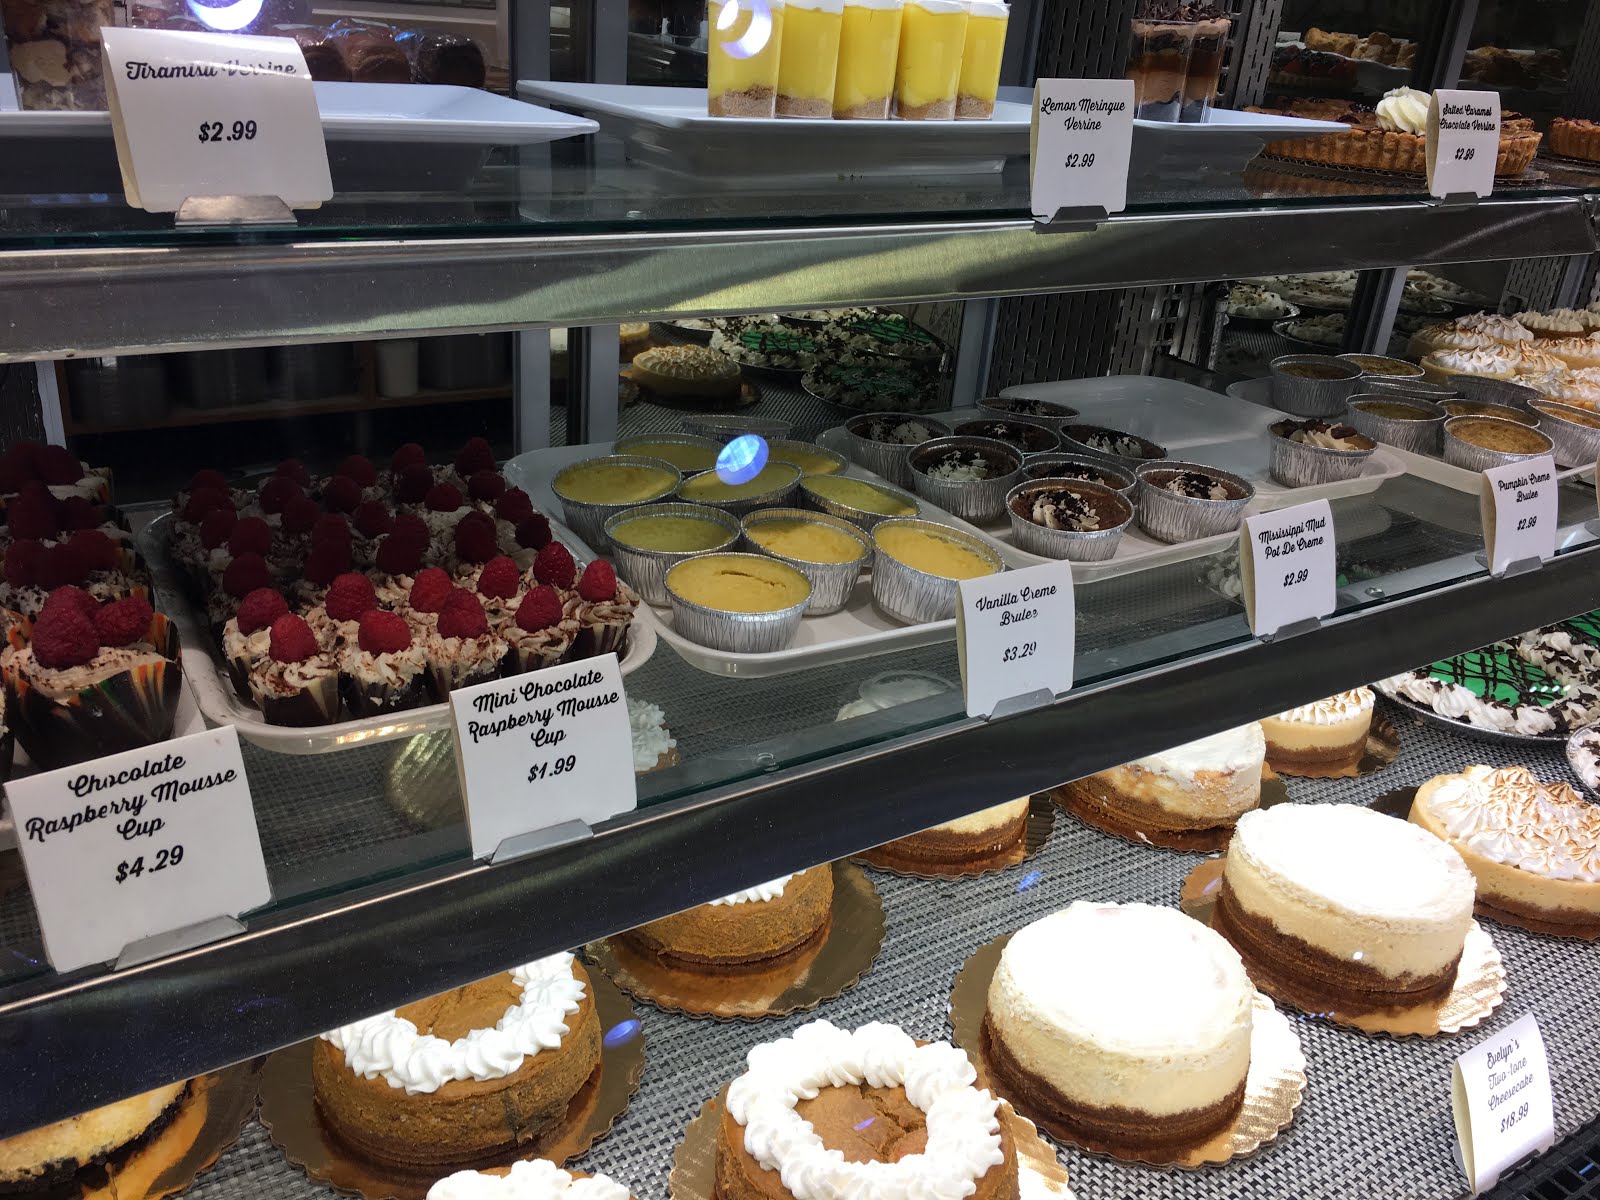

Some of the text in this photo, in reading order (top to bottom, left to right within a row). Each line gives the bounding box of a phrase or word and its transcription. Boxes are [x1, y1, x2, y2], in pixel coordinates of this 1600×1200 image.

[126, 61, 218, 80] Tiramisu
[1041, 97, 1125, 116] Lemon Meringue
[1443, 103, 1492, 117] Salted Caramel
[198, 120, 257, 143] $2.99
[1064, 117, 1101, 131] Verrine
[1440, 118, 1495, 131] Chocolate Verrine
[1065, 153, 1095, 168] $2.99
[1454, 147, 1475, 160] $2.99
[1498, 473, 1550, 491] Pumpkin Creme
[1516, 490, 1539, 503] Brulee
[1258, 516, 1326, 544] Mississippi Mud
[1517, 515, 1537, 531] $2.99
[1265, 536, 1324, 560] Pot De Creme
[1283, 568, 1309, 588] $2.99
[975, 585, 1057, 612] Vanilla Creme
[999, 608, 1038, 627] Brulee
[1002, 641, 1037, 663] $3.29
[473, 669, 604, 714] Mini Chocolate
[468, 692, 619, 744] Raspberry Mousse
[531, 728, 567, 748] Cup
[68, 754, 187, 797] Chocolate
[527, 755, 576, 783] $1.99
[25, 769, 238, 842] Raspberry Mousse
[116, 817, 165, 841] Cup
[115, 844, 184, 884] $4.29
[1488, 1057, 1527, 1090] Two-tone
[1487, 1073, 1533, 1111] Cheesecake
[1500, 1101, 1529, 1133] $18.99
